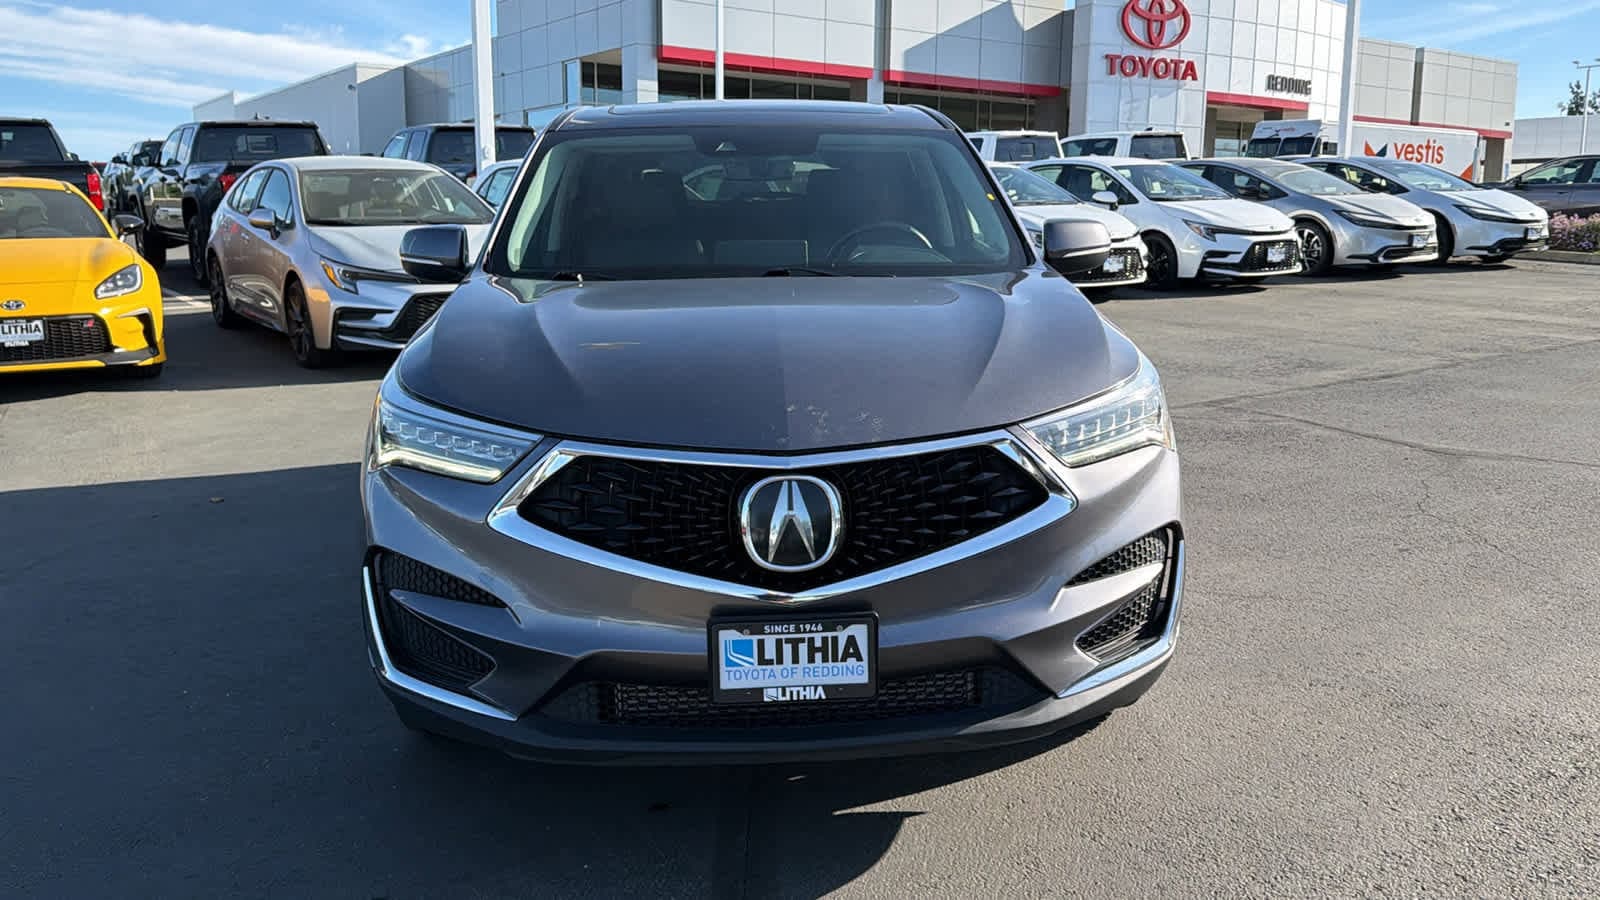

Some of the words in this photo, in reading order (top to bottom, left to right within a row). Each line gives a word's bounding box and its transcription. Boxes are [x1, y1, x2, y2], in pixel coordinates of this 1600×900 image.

[1104, 54, 1198, 81] TOYOTA
[1265, 74, 1312, 95] REDDING
[1393, 138, 1445, 164] vestis
[1, 324, 41, 335] LITHIA
[763, 624, 796, 634] SINCE
[799, 623, 823, 633] 1946
[757, 635, 864, 666] LITHIA
[725, 668, 777, 681] TOYOTA
[780, 667, 798, 679] OF
[803, 664, 865, 678] REDDING
[778, 685, 826, 701] LITHIA
